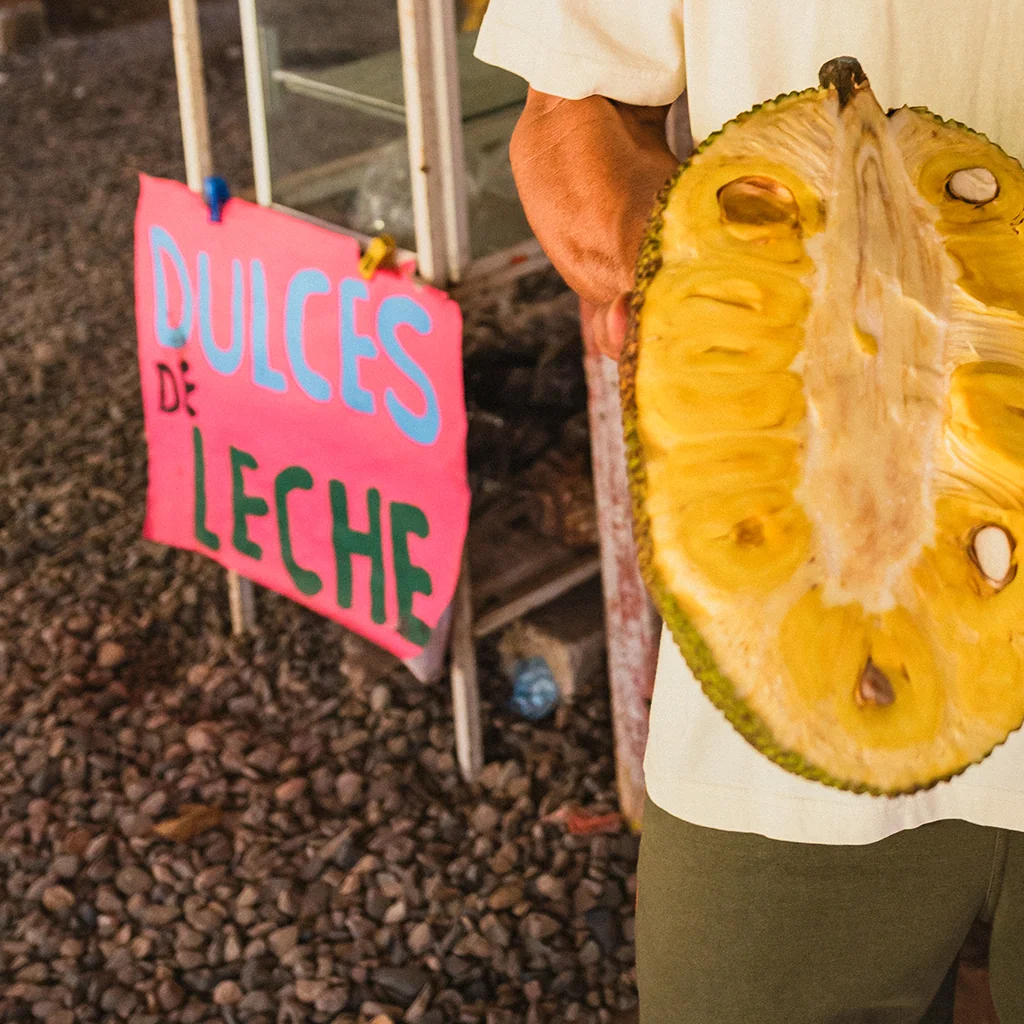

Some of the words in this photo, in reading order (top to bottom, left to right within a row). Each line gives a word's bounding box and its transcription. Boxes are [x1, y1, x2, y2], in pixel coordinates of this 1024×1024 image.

[149, 225, 442, 445] DULCES
[157, 360, 197, 417] DE
[192, 426, 434, 648] LECHE
